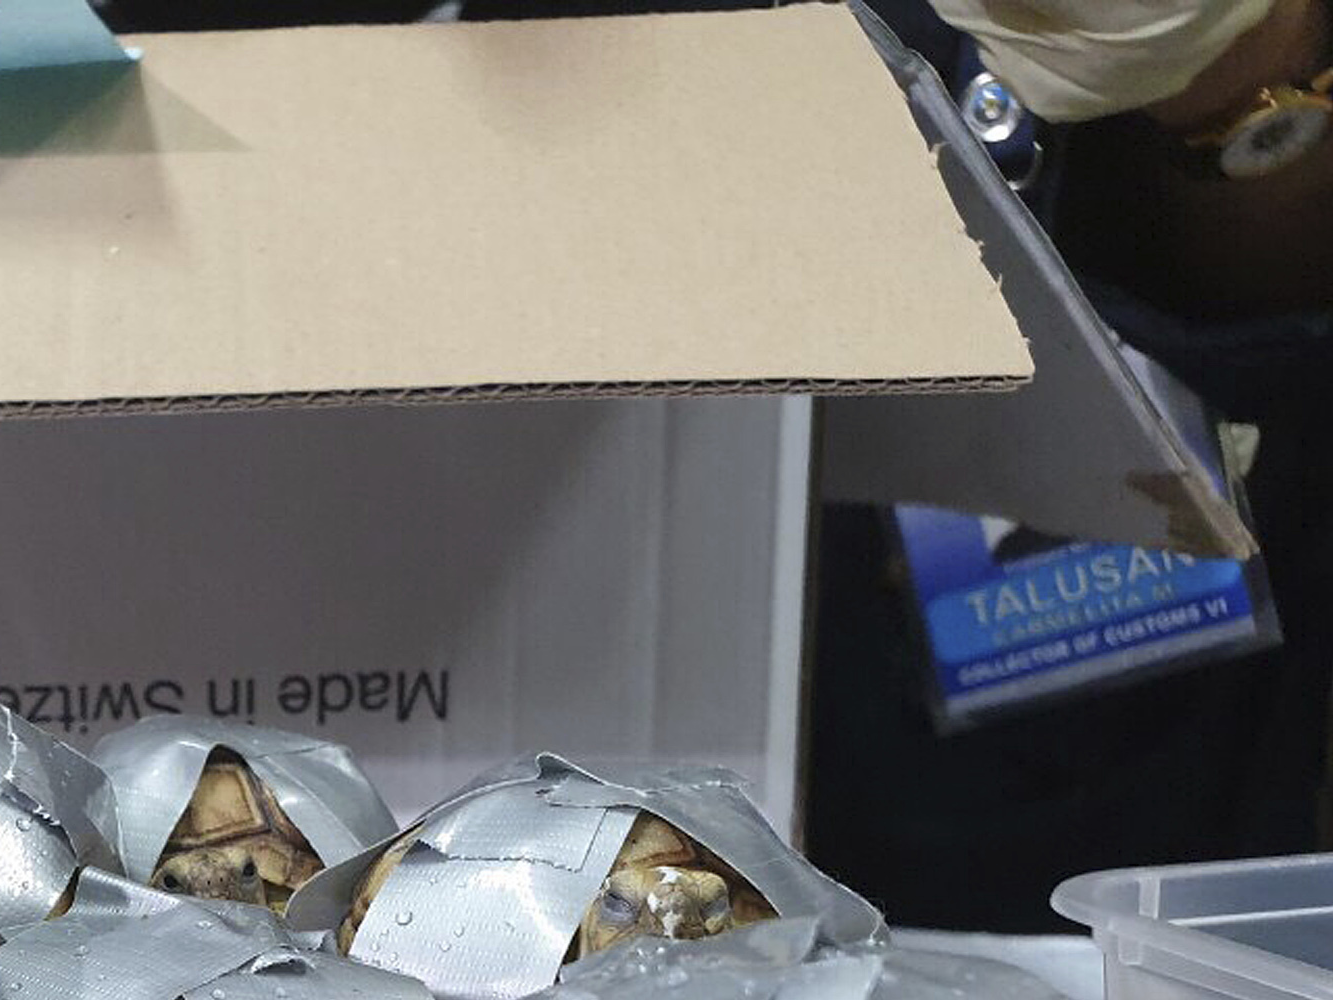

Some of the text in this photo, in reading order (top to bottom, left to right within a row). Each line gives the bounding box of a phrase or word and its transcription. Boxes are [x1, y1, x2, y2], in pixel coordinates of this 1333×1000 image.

[1072, 631, 1099, 652] OF
[1103, 603, 1202, 647] CUSTOMS
[1206, 596, 1229, 618] VI
[207, 678, 255, 726] in
[277, 669, 450, 725] Made
